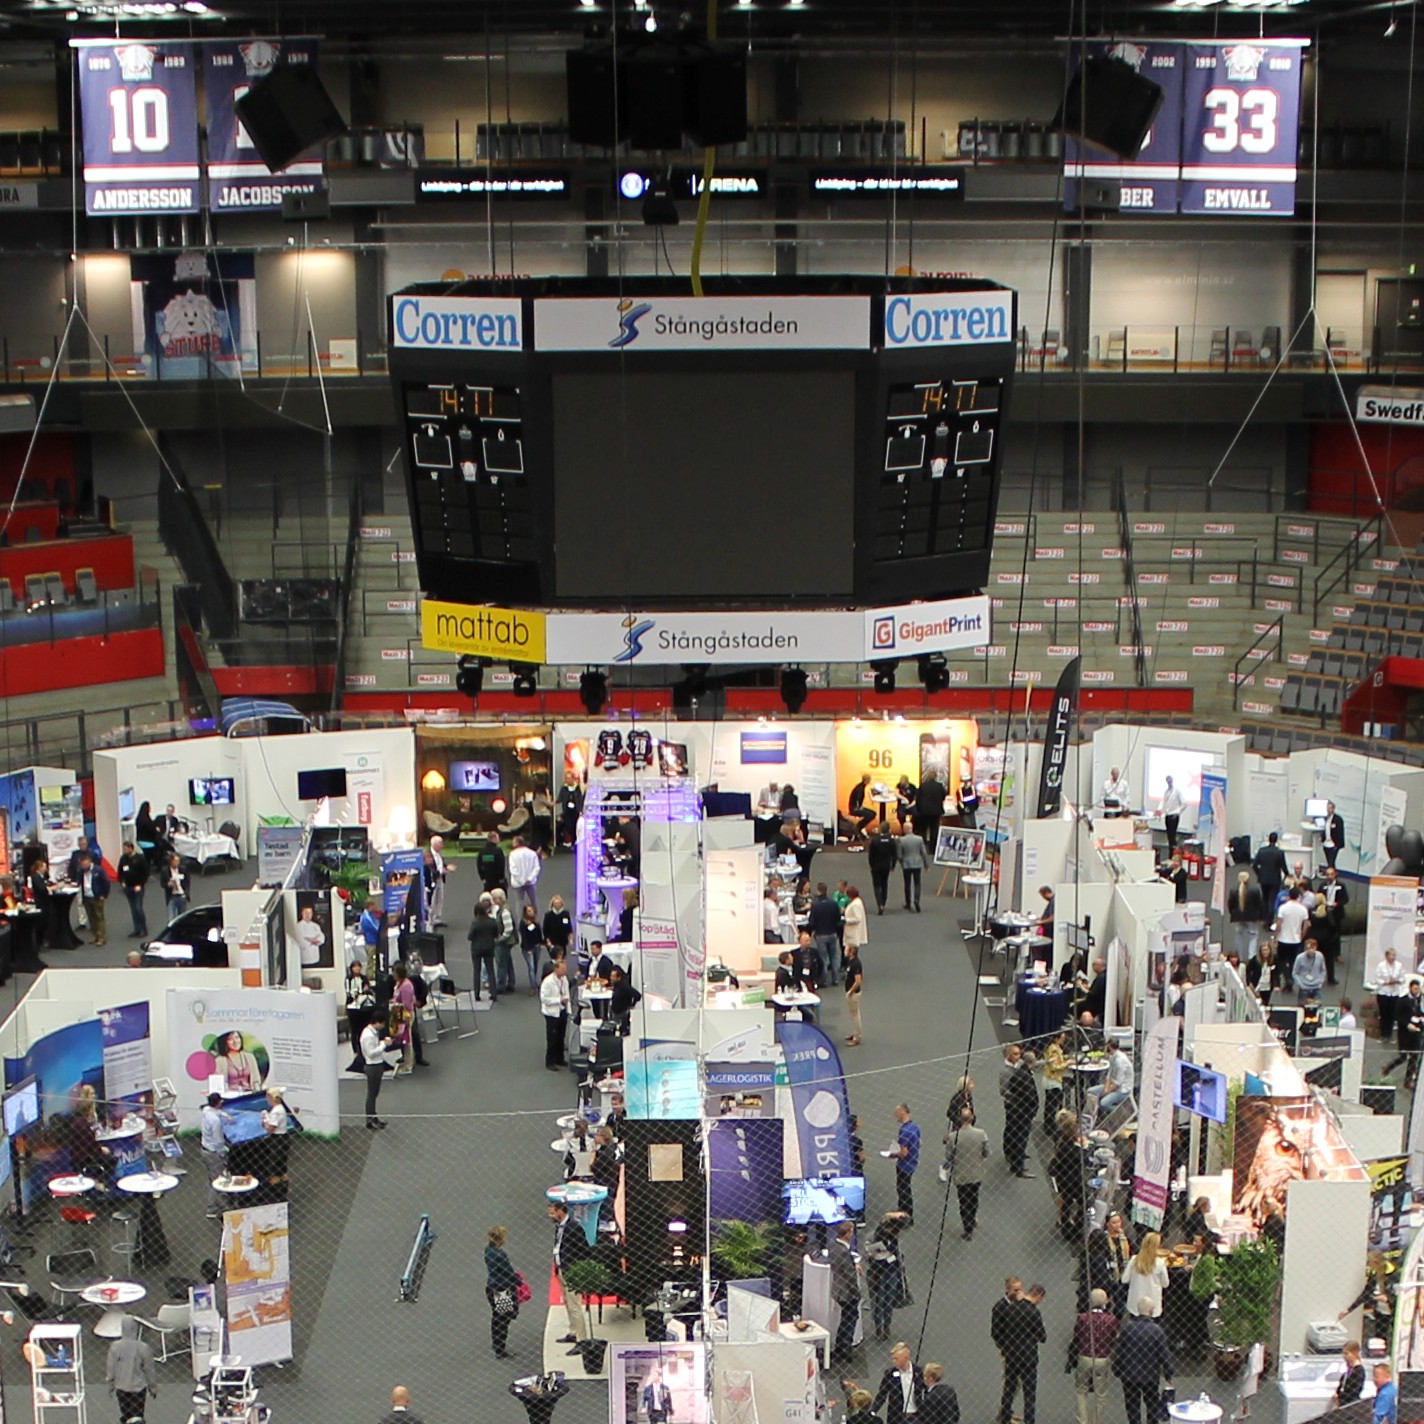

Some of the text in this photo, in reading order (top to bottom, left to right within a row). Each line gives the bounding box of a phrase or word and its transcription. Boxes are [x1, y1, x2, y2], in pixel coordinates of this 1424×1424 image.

[110, 87, 170, 152] 10
[1202, 88, 1278, 153] 33
[93, 188, 193, 209] ANDERSSON
[1203, 188, 1271, 209] EMVALL
[395, 299, 520, 347] Corren
[655, 312, 799, 341] Stångåstaden
[886, 297, 1008, 344] Corren
[436, 612, 529, 646] mattab
[658, 626, 799, 655] Stångåstaden
[899, 613, 983, 643] GigantPrint
[1050, 697, 1071, 764] ELITS
[868, 749, 894, 769] 96
[785, 1409, 802, 1418] G41
